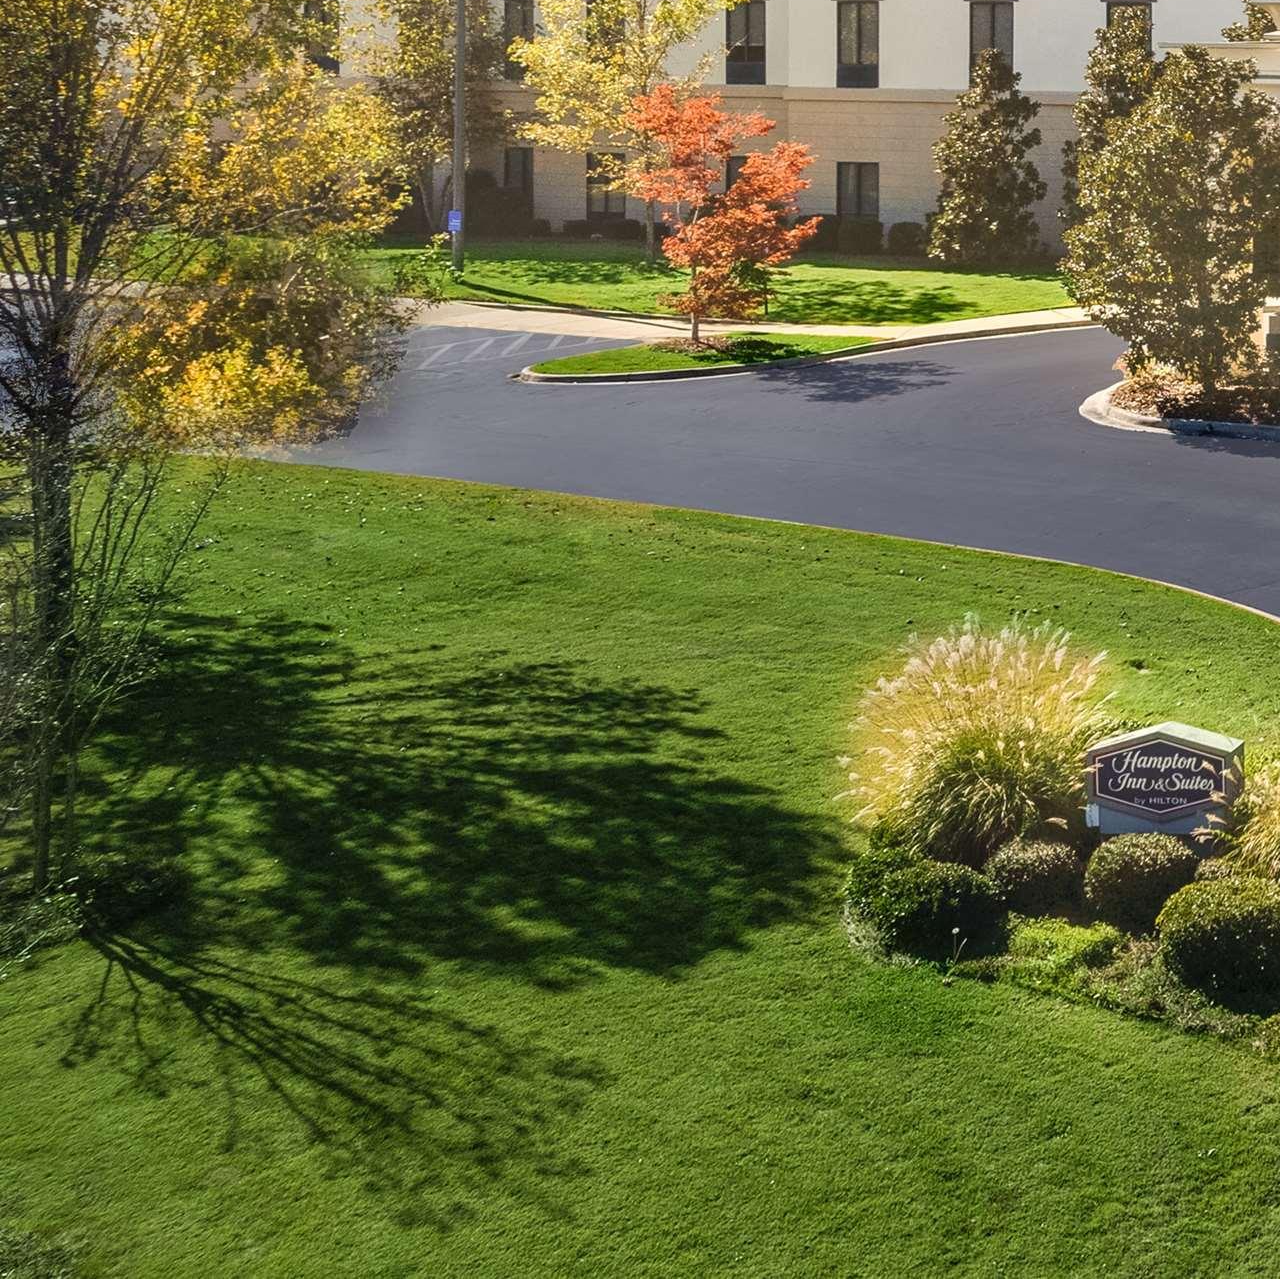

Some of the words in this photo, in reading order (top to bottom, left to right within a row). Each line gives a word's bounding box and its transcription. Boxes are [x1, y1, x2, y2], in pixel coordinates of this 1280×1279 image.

[1112, 751, 1203, 773] Hampton
[1108, 773, 1155, 792] Inn
[1154, 778, 1167, 792] &
[1165, 773, 1214, 792] Suites
[1134, 796, 1146, 806] by
[1149, 797, 1187, 805] HILTON
